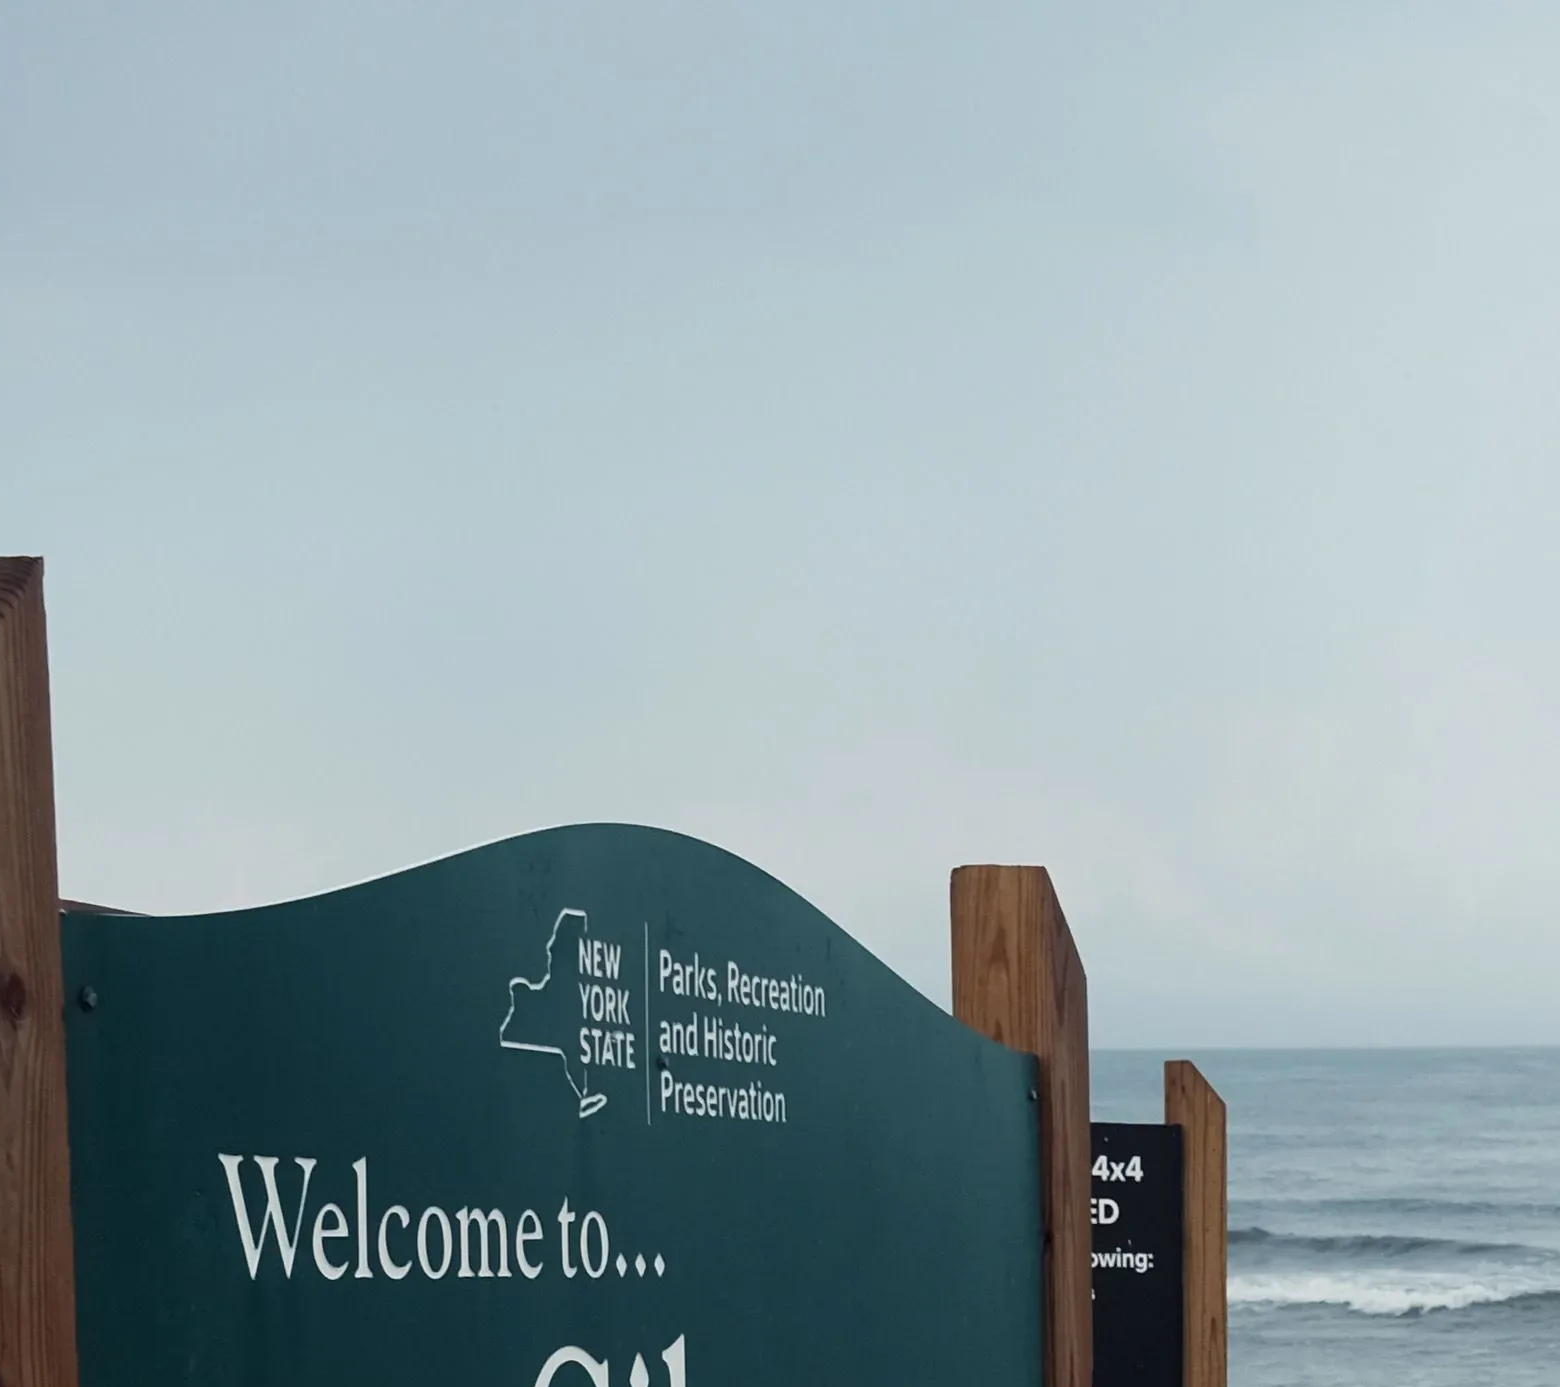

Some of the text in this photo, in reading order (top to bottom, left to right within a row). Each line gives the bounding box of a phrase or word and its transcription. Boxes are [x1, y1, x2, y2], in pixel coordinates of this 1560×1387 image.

[578, 937, 622, 981] NEW
[658, 948, 827, 1018] Parks, Recreation
[578, 981, 631, 1026] YORK
[579, 1026, 636, 1070] STATE
[658, 1012, 778, 1067] and Historic
[660, 1070, 787, 1124] Preservation
[1091, 1154, 1144, 1183] 4x4
[217, 1152, 667, 1281] Welcome to...
